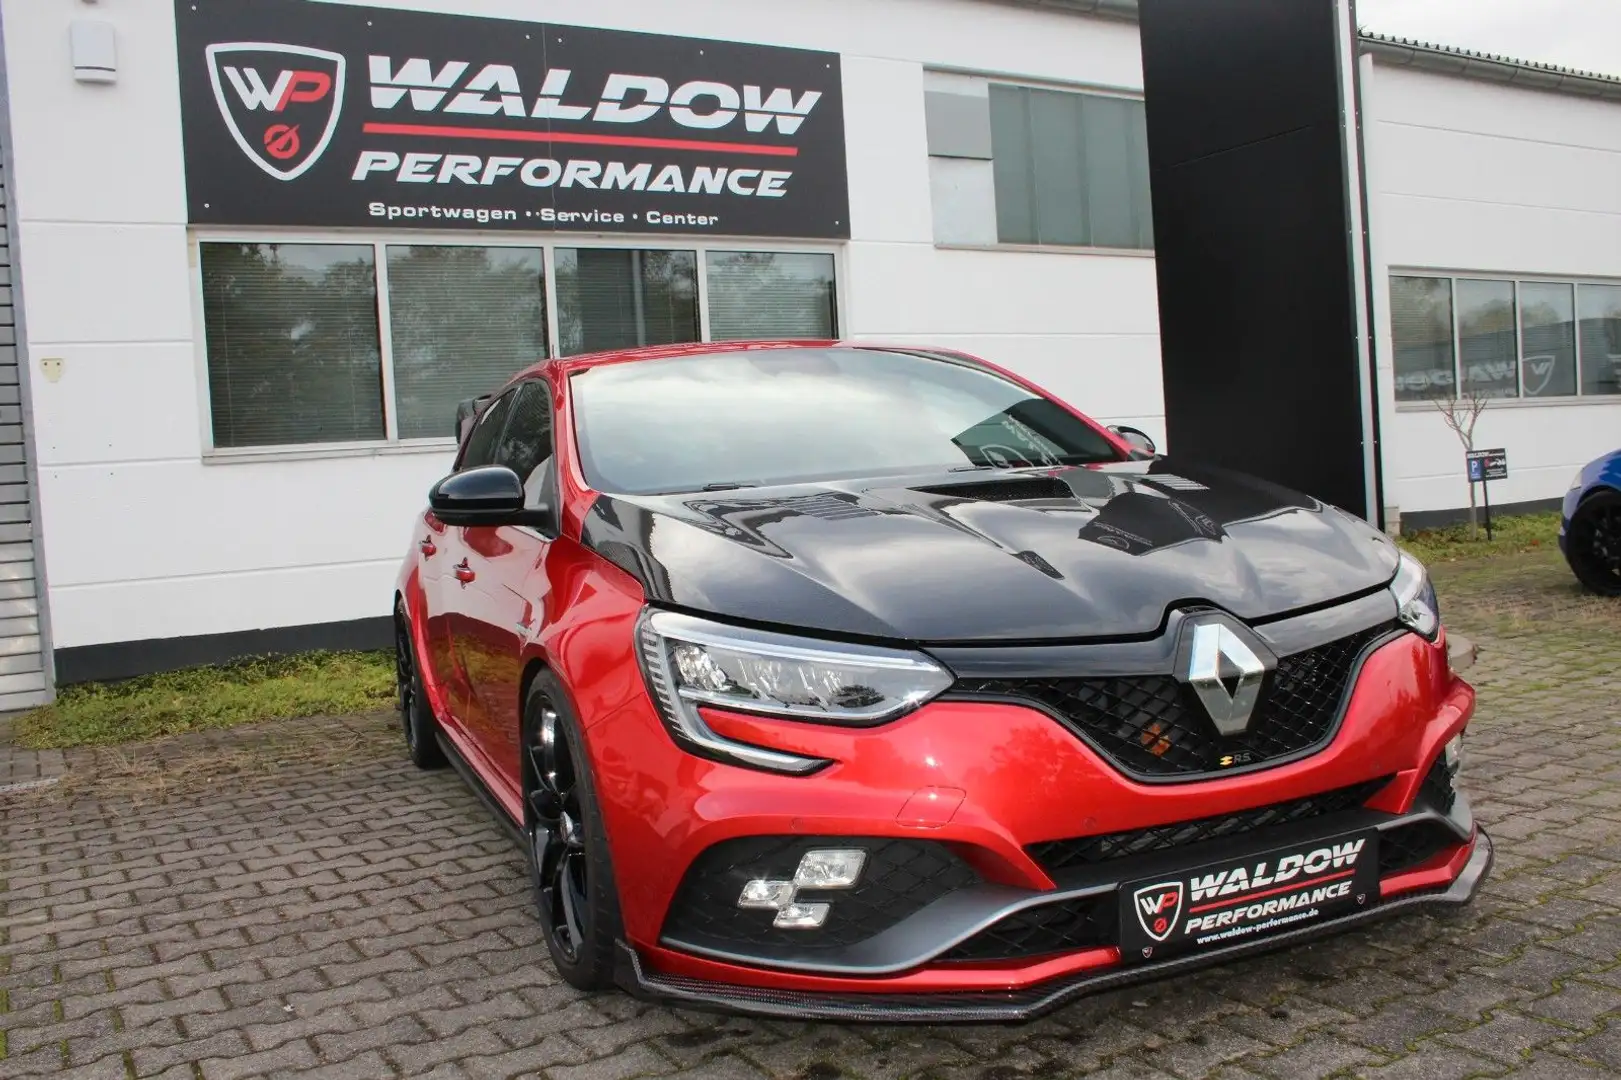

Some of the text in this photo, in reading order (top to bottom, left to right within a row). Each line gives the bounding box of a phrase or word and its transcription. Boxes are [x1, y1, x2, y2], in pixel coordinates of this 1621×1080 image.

[368, 55, 822, 135] WALDOW
[351, 150, 794, 198] PERFORMANCE
[368, 201, 719, 226] Sportwagen Service Center
[1190, 838, 1366, 902] WALDOW
[1184, 880, 1353, 935] PERFORMANCE
[1196, 907, 1320, 945] www.waldow-performance.de
